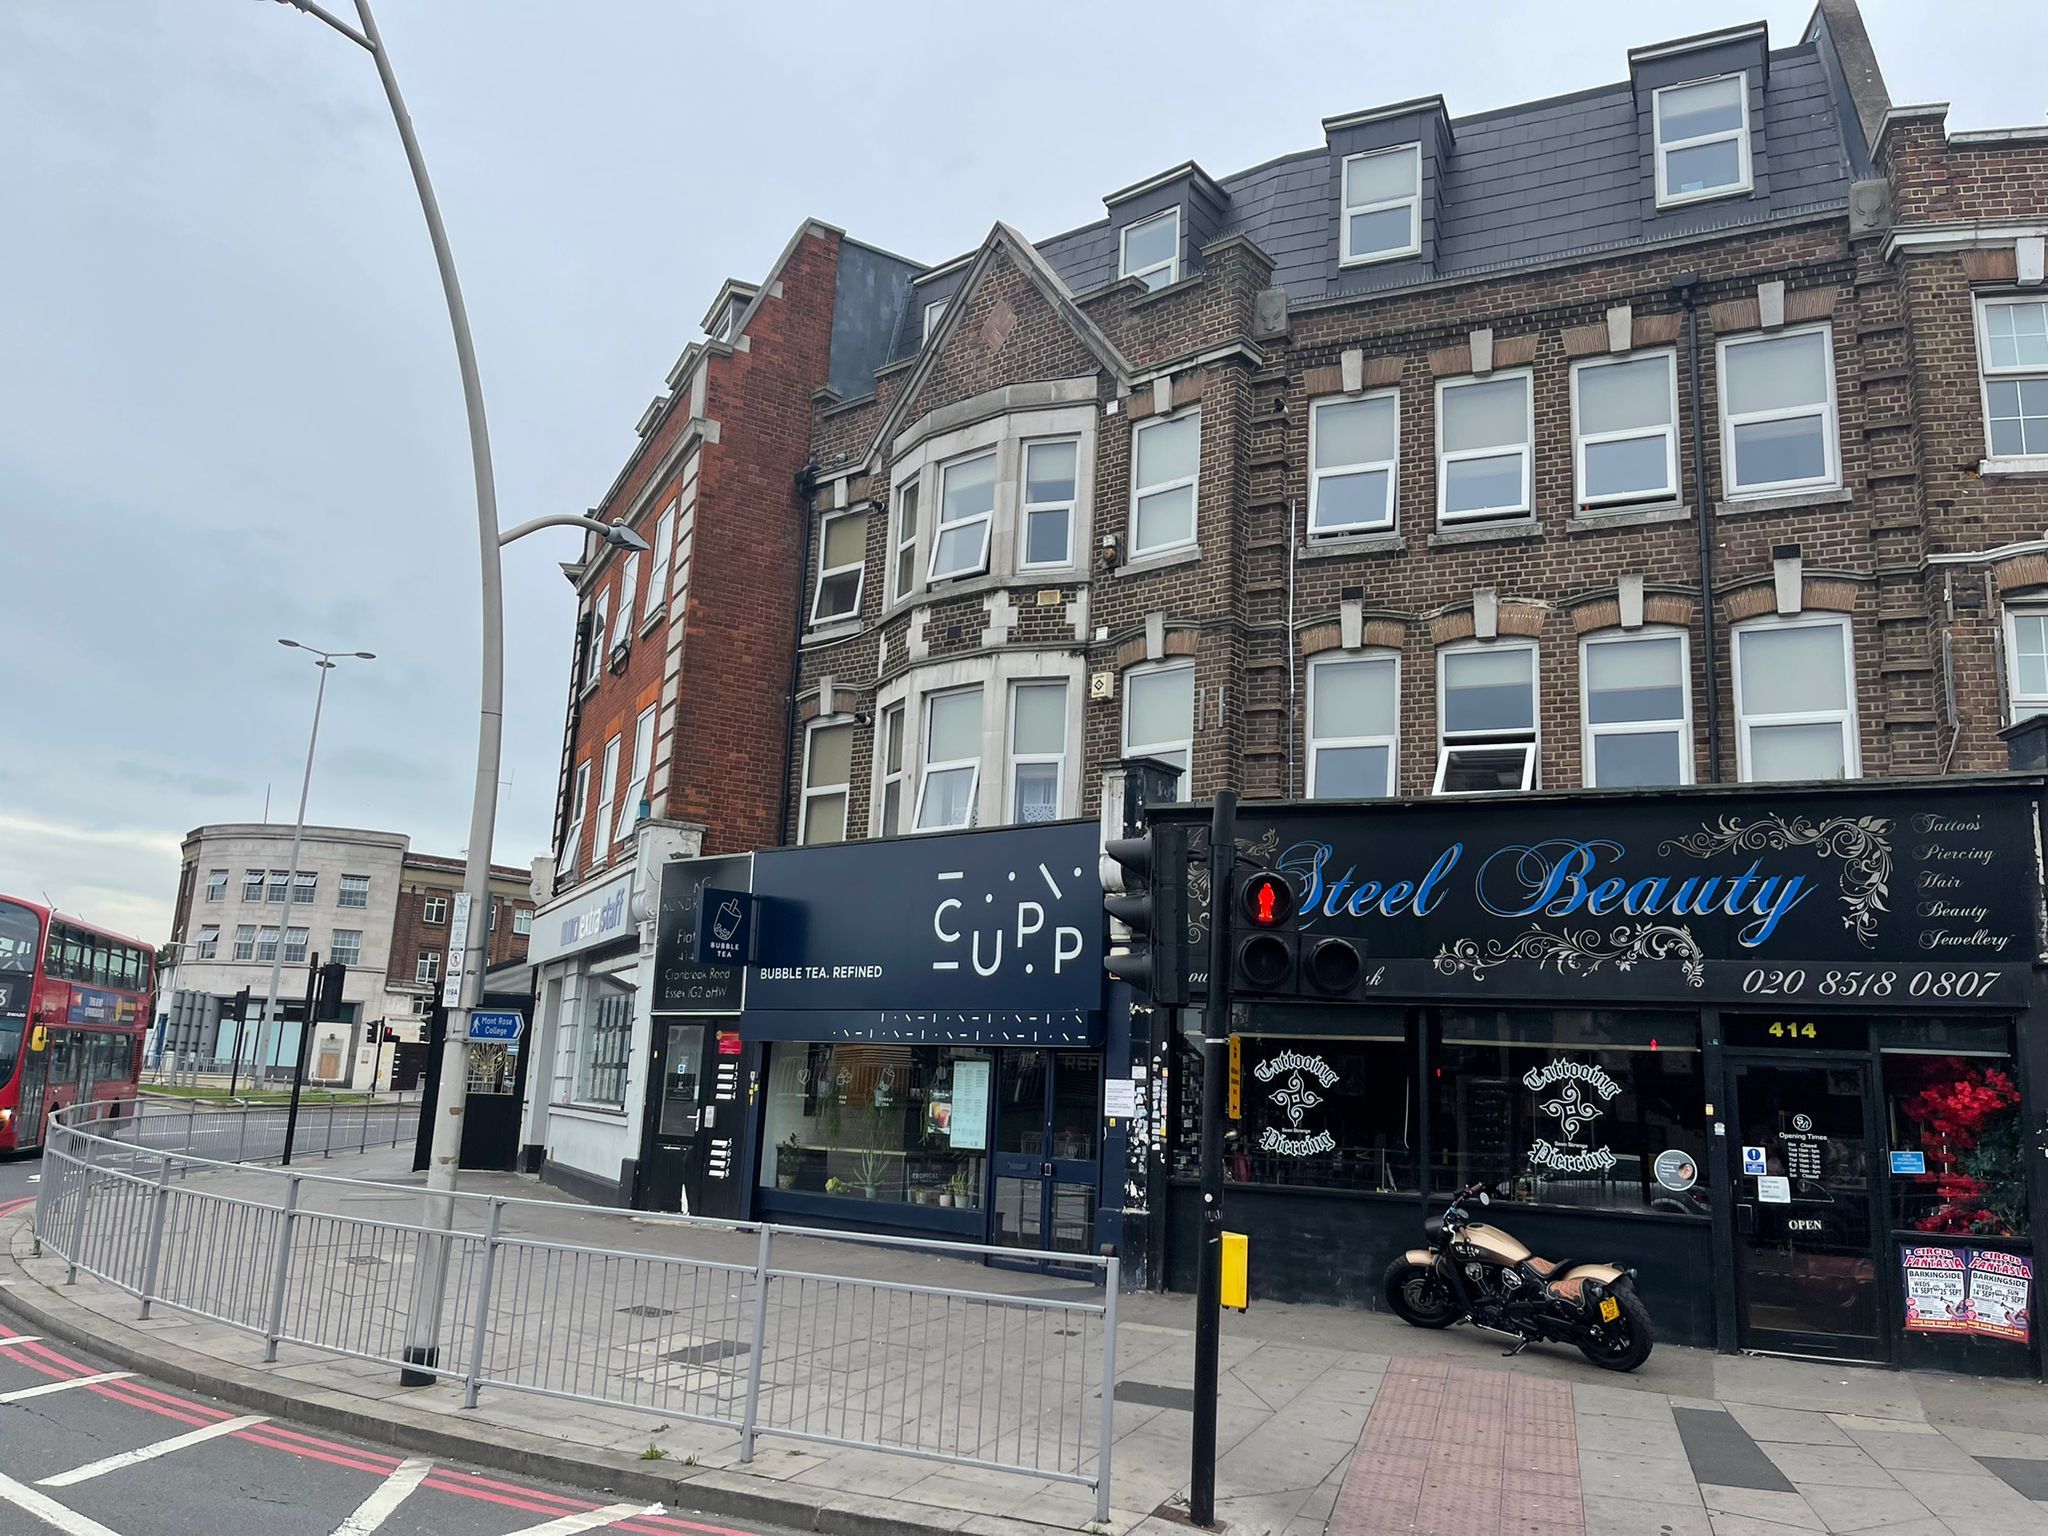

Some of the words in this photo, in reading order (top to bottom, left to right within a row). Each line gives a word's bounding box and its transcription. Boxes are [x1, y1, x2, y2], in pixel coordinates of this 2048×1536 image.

[1913, 844, 1995, 866] Piercing
[1916, 870, 1963, 897] Hair
[1276, 840, 1463, 930] Steel
[1475, 838, 1819, 948] Beauty
[1917, 900, 1990, 923] Beauty
[933, 898, 1084, 977] CUPP
[1919, 929, 2009, 952] Jewellery
[709, 941, 740, 951] BUBBLE
[717, 950, 732, 958] TEA
[760, 967, 803, 980] BUBBLE
[805, 966, 830, 979] TEA.
[833, 965, 883, 979] REFINED
[1742, 968, 1806, 995] 020
[1818, 969, 1898, 997] 8518
[1909, 970, 2001, 998] 0807
[482, 1016, 498, 1025] Mont
[498, 1016, 513, 1026] Rose
[484, 1026, 508, 1037] College
[1768, 1021, 1817, 1039] 414
[1254, 1049, 1340, 1089] Tattooing
[1523, 1057, 1622, 1101] Tattooing
[1259, 1126, 1336, 1157] Piercing
[1779, 1131, 1806, 1141] Opening
[1807, 1133, 1828, 1141] Times
[1528, 1138, 1618, 1173] Piercing
[1788, 1219, 1822, 1231] OPEN
[1914, 1247, 1954, 1257] CIRCUS
[1981, 1251, 2022, 1266] CIRCUS
[1903, 1256, 1966, 1270] FANTASIA
[1968, 1257, 2033, 1280] FANTASIA
[1909, 1270, 1962, 1280] BARKINGSIDE
[1972, 1271, 2027, 1288] BARKINGSIDE
[1920, 1287, 1934, 1295] SEPT
[1976, 1283, 1993, 1291] WEDS
[1981, 1289, 1995, 1299] SEPT
